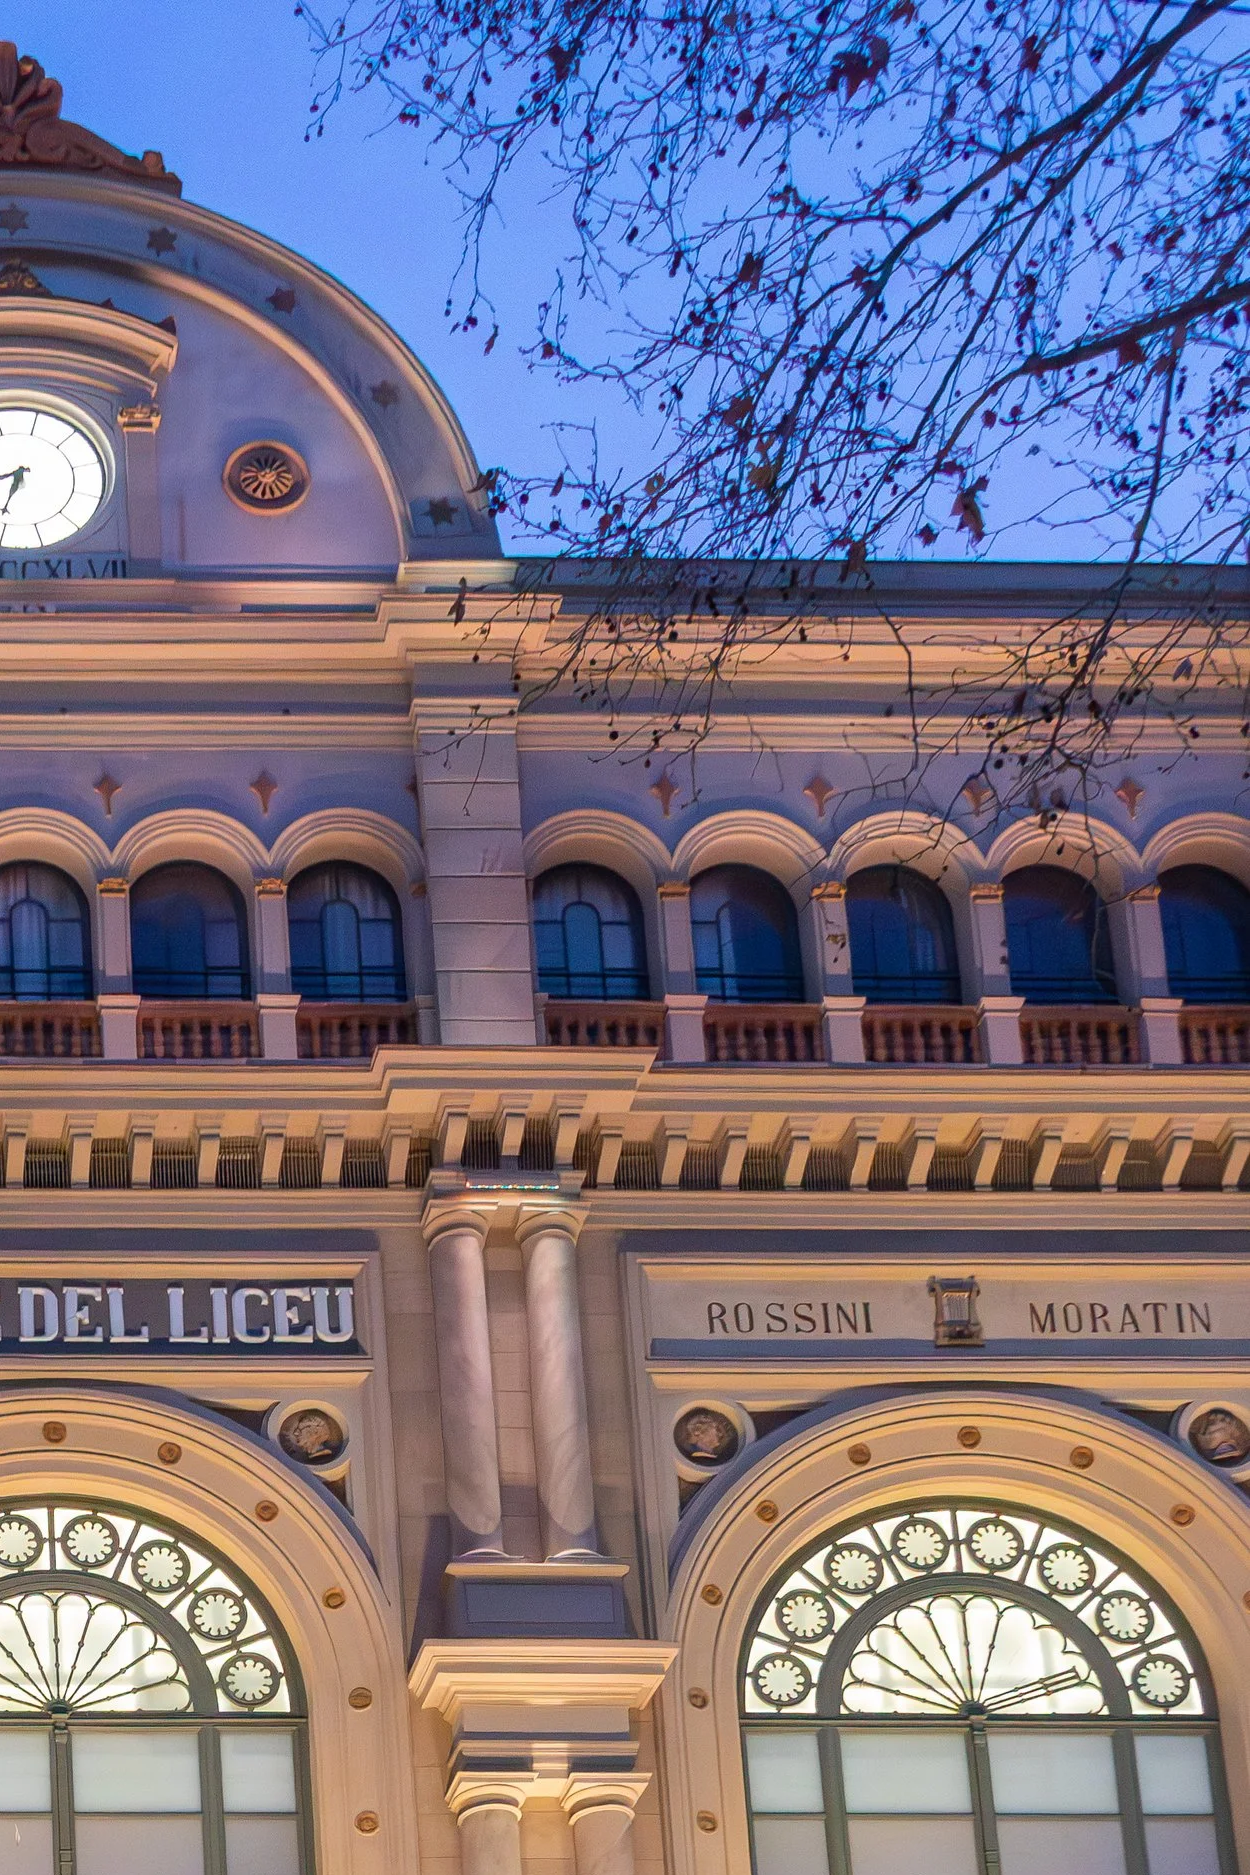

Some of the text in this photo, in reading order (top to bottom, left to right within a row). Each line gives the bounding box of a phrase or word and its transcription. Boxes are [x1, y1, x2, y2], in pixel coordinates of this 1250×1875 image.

[17, 1284, 150, 1345] DEL
[166, 1285, 354, 1345] LICEU
[706, 1301, 874, 1334] ROSSINI
[1028, 1301, 1213, 1334] MORATIN
